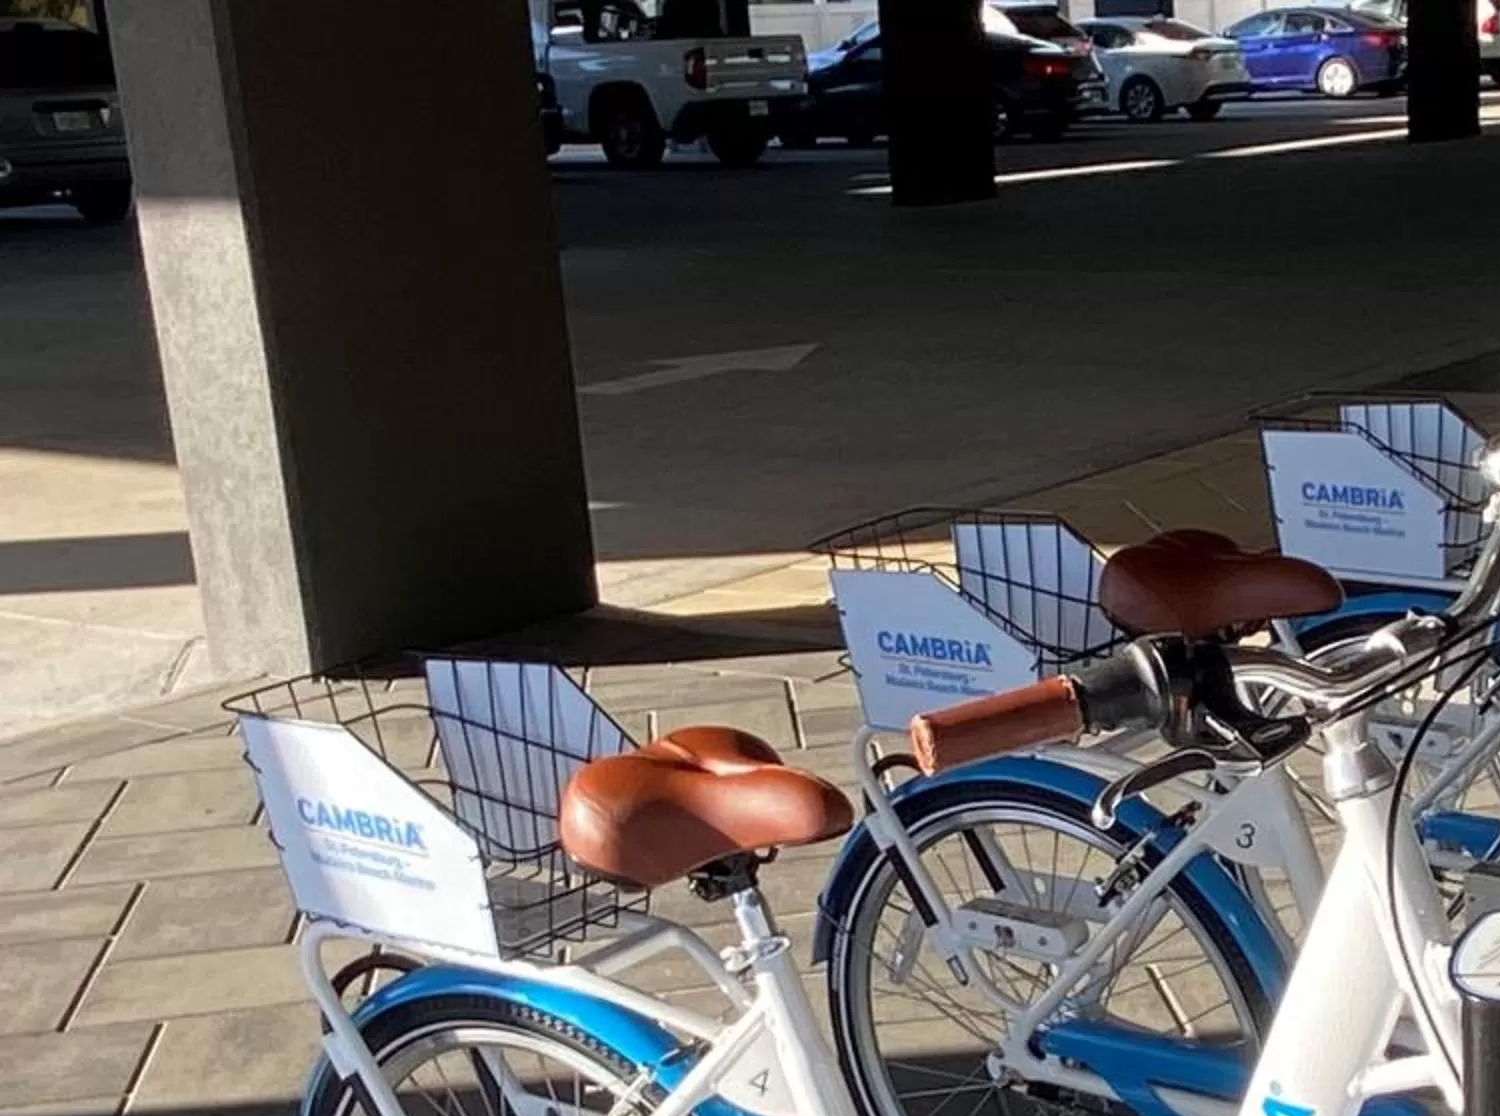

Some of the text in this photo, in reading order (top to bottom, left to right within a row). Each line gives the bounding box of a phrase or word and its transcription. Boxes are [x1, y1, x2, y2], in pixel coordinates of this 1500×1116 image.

[878, 630, 992, 666] CAMBRiA
[297, 797, 427, 851] CAMBRiA
[1235, 823, 1256, 849] 3
[748, 1068, 770, 1096] 4
